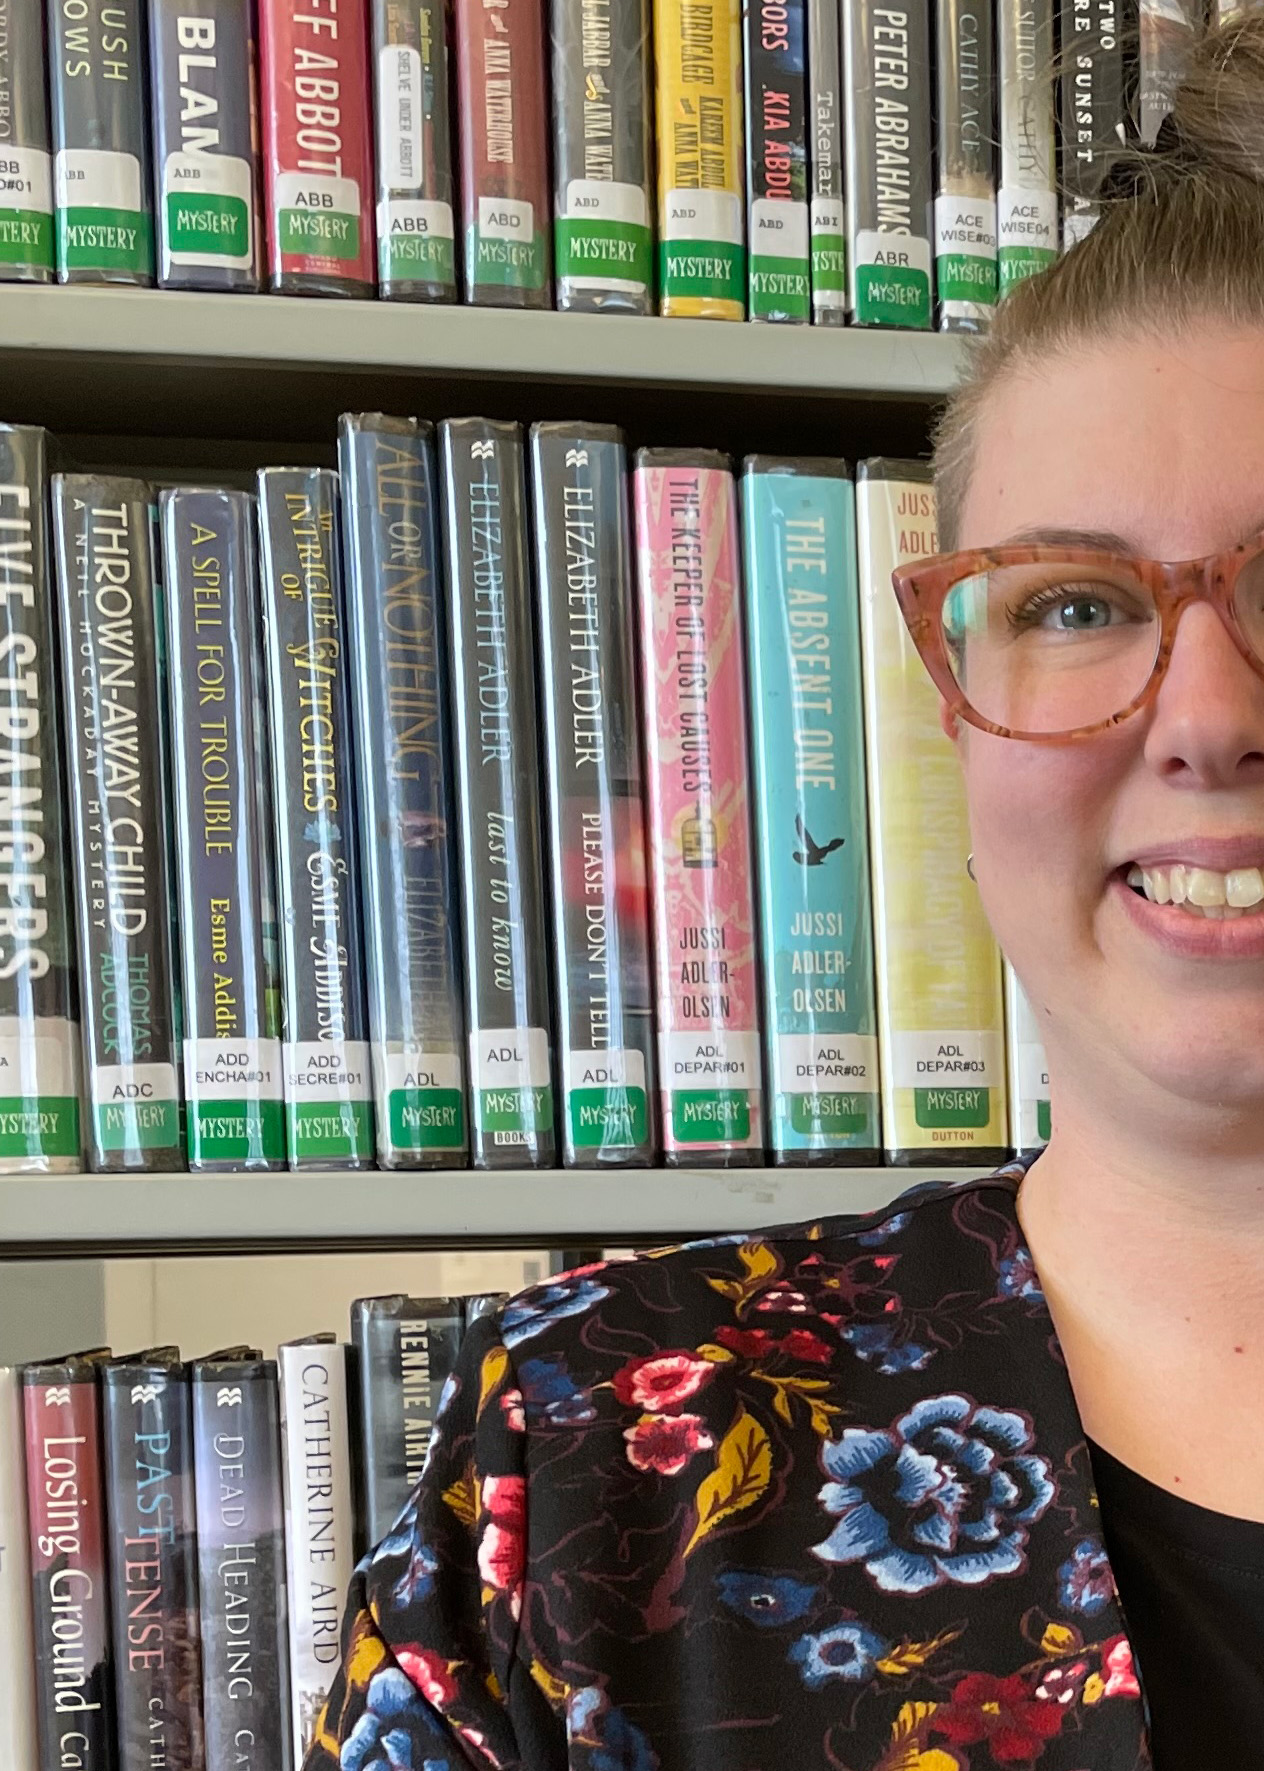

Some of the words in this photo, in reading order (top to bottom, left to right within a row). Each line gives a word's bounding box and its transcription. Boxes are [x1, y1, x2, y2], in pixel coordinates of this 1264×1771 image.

[873, 8, 909, 92] PETER
[959, 14, 981, 98] CATHY
[486, 79, 514, 163] WATERHOUSE
[762, 90, 791, 131] KIA
[1076, 56, 1094, 163] SUNSET
[961, 103, 981, 156] ACE
[173, 168, 201, 179] ABB
[295, 192, 334, 208] ABB
[575, 197, 600, 208] ABD
[671, 209, 696, 219] ABD
[1010, 206, 1040, 219] ACE
[177, 209, 239, 236] MYSTERY
[288, 213, 350, 241] MYSTERY
[391, 217, 428, 232] ABB
[488, 213, 521, 227] ABD
[758, 220, 784, 230] ABD
[815, 216, 838, 227] ABI
[955, 214, 983, 228] ACE
[66, 224, 137, 251] MYSTERY
[570, 237, 637, 262] MYSTERY
[667, 257, 733, 281] MYSTERY
[874, 251, 910, 266] ABR
[868, 281, 921, 306] MYSTERY
[375, 437, 426, 517] ALL
[669, 478, 700, 519] THE
[190, 522, 218, 546] A
[785, 516, 827, 575] THE
[75, 533, 91, 598] NEIL
[468, 482, 508, 648] ELIZABETH
[562, 486, 601, 652] ELIZABETH
[670, 526, 704, 609] KEEPER
[191, 555, 223, 635] SPELL
[281, 572, 304, 602] OF
[675, 615, 706, 642] OF
[91, 503, 143, 809] THROWN-AWAY
[787, 588, 833, 715] ABSENT
[196, 644, 226, 707] FOR
[677, 651, 708, 704] LOST
[286, 637, 338, 812] WITCHES
[477, 660, 512, 766] ADLER
[570, 663, 606, 769] ADLER
[679, 710, 713, 794] CAUSES
[792, 729, 836, 791] ONE
[199, 715, 233, 857] TROUBLE
[487, 811, 513, 866] last
[581, 812, 606, 896] PLEASE
[104, 816, 148, 937] CHILD
[488, 876, 511, 904] to
[210, 897, 231, 964] Esme
[679, 927, 726, 950] JUSSI
[790, 912, 844, 937] JUSSI
[491, 916, 519, 991] know
[791, 950, 853, 975] ADLER-
[100, 951, 119, 1054] ADCOCK
[128, 952, 153, 1056] THOMAS
[791, 988, 847, 1013] OLSEN
[215, 1053, 250, 1066] ADD
[307, 1055, 341, 1068] ADD
[486, 1048, 523, 1062] ADL
[696, 1046, 724, 1058] ADL
[817, 1049, 845, 1062] ADL
[916, 1060, 986, 1073] DEPAR#03
[937, 1046, 964, 1058] ADL
[288, 1072, 362, 1085] SECRE#01
[404, 1073, 440, 1086] ADL
[582, 1069, 619, 1082] ADL
[674, 1061, 746, 1074] DEPAR#01
[796, 1065, 867, 1077] DEPAR#02
[113, 1083, 153, 1099] ADC
[927, 1090, 981, 1111] MYSTERY
[401, 1105, 457, 1128] MYSTERY
[683, 1102, 740, 1123] MYSTERY
[931, 1131, 975, 1143] DUTTON
[399, 1319, 431, 1410] RENNIE
[301, 1363, 336, 1566] CATHERINE
[134, 1428, 175, 1548] PAST
[212, 1431, 247, 1528] DEAD
[37, 1433, 88, 1557] Losing
[124, 1533, 165, 1672] TENSE
[216, 1541, 258, 1700] HEADING
[310, 1579, 339, 1665] AIRD
[49, 1568, 101, 1713] Ground
